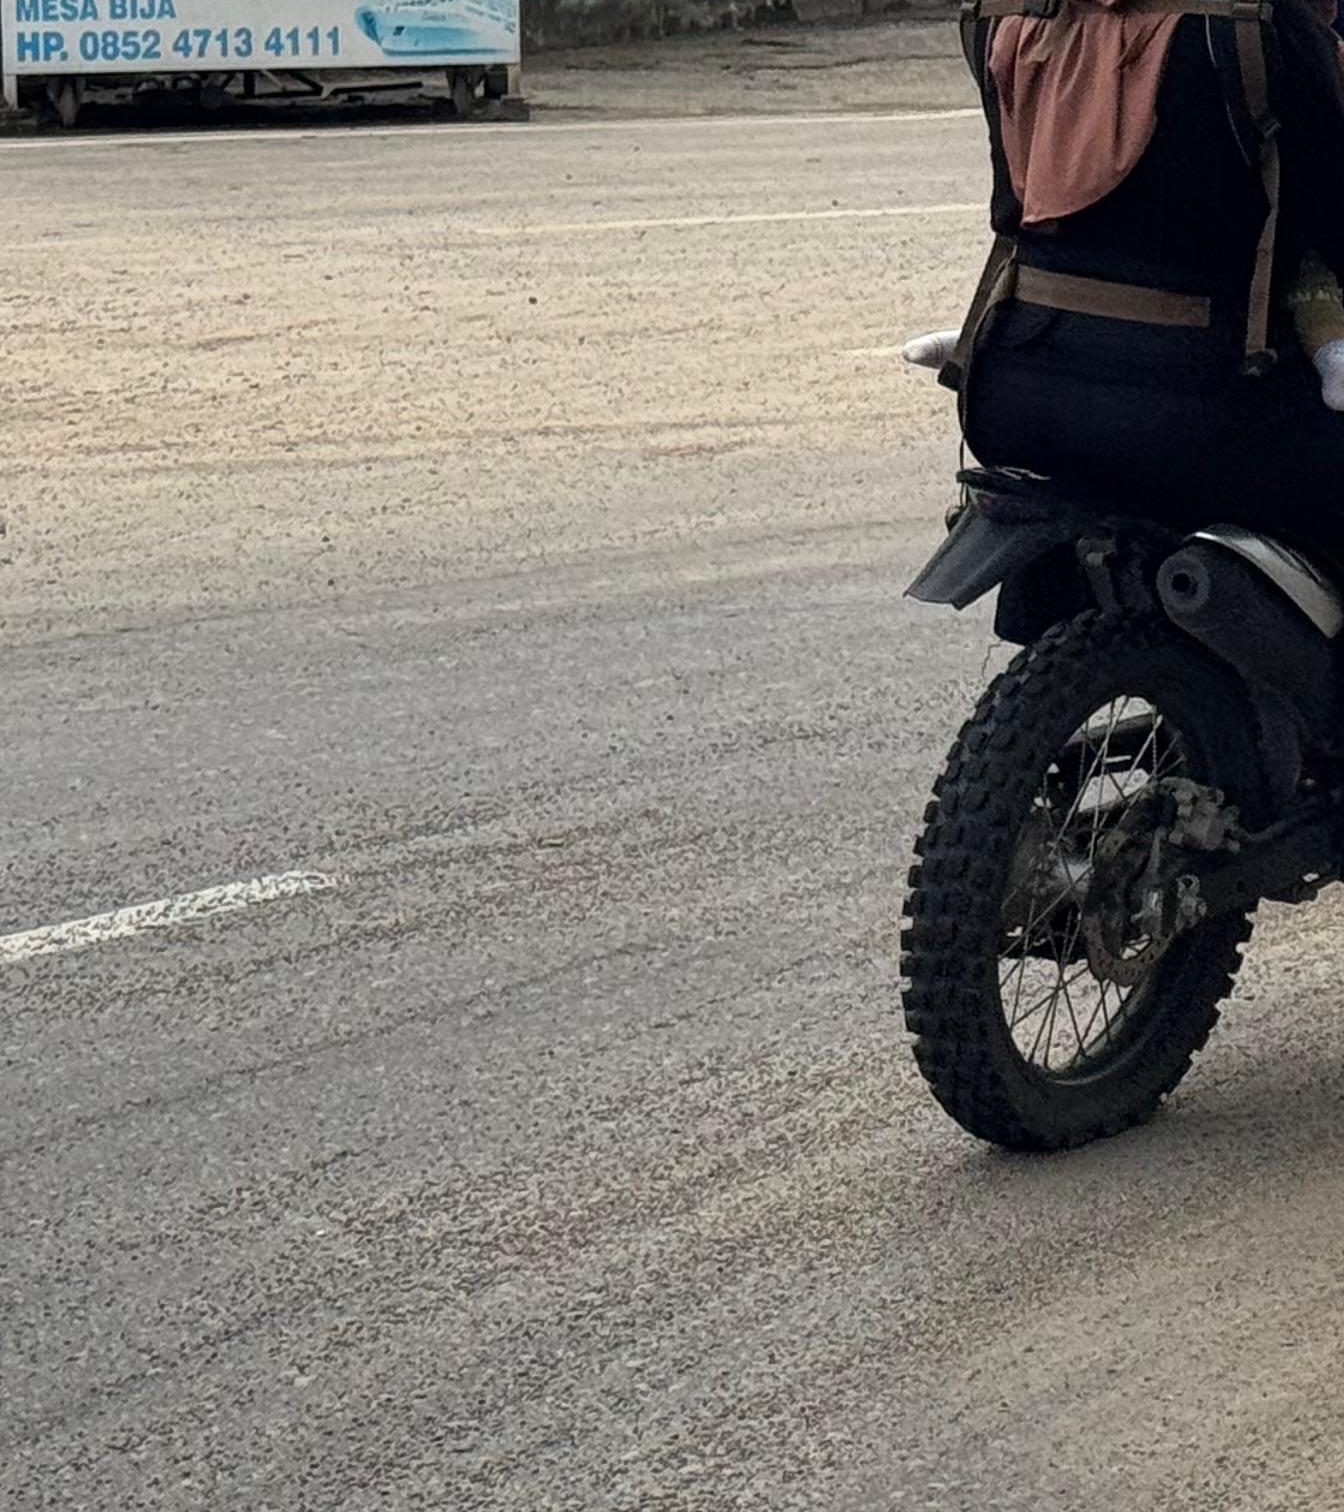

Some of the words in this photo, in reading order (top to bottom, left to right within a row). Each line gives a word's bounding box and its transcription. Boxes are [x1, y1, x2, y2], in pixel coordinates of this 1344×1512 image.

[16, 31, 68, 63] HP.
[80, 29, 161, 60] 0852
[172, 27, 253, 59] 4713
[264, 26, 341, 57] 4111
